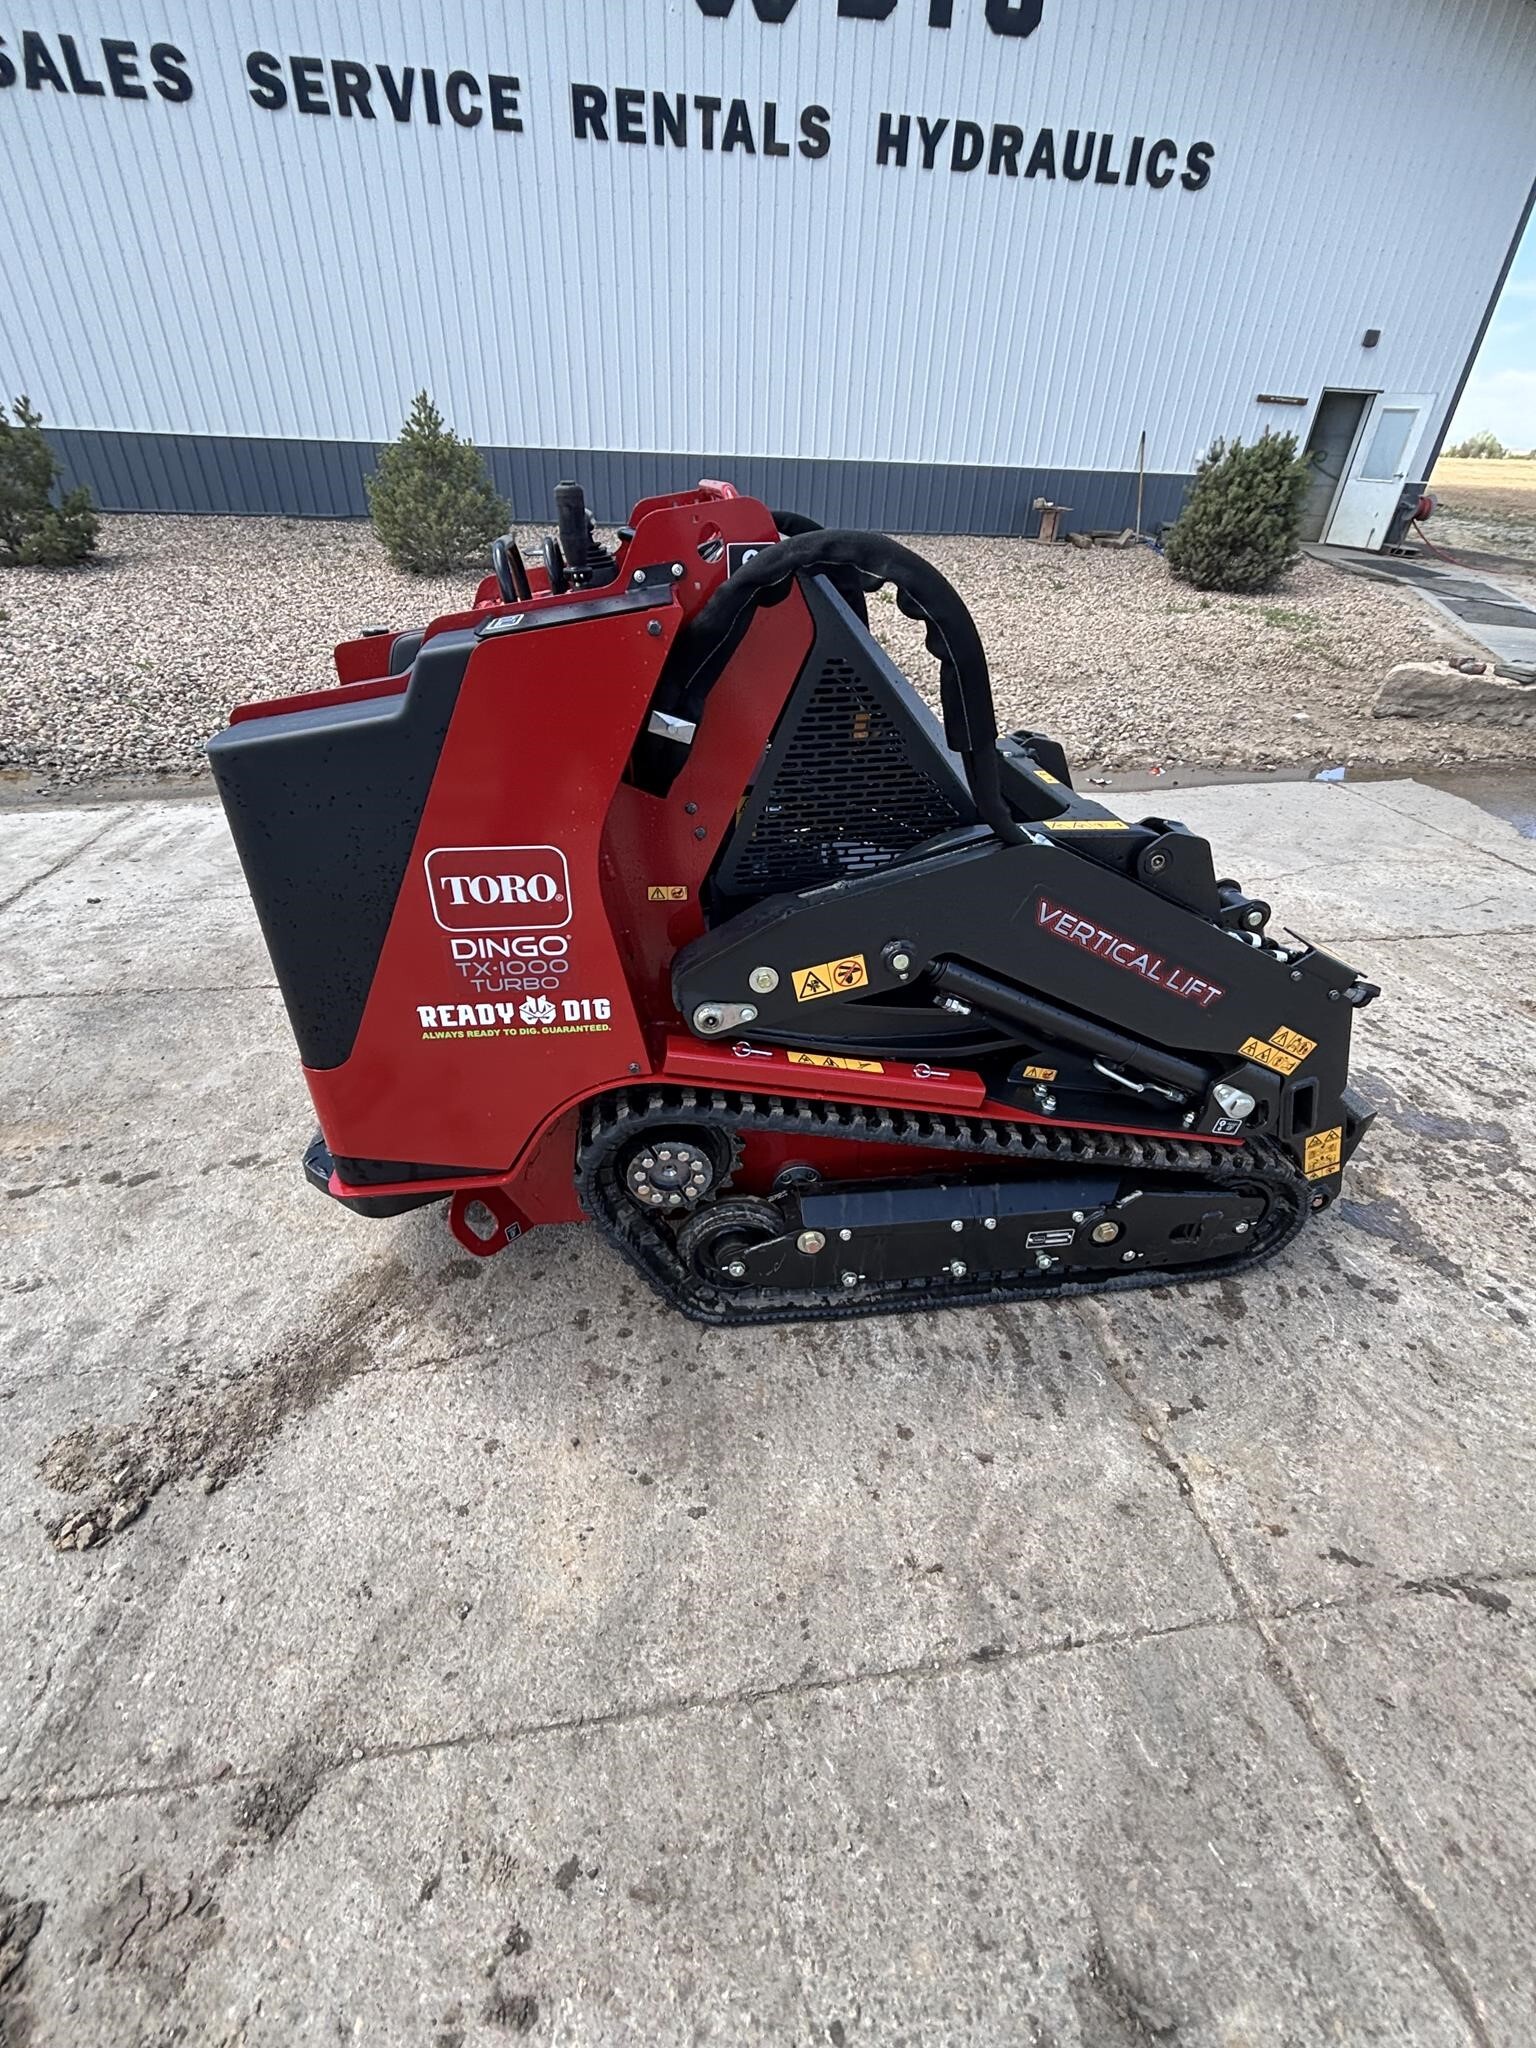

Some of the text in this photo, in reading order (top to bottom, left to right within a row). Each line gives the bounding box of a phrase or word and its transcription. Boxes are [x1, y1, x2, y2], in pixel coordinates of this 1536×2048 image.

[246, 51, 524, 133] SERVICE
[570, 83, 832, 160] RENTALS
[876, 112, 1216, 191] HYDRAULICS
[440, 873, 558, 905] TORO
[450, 935, 569, 960] DINGO
[1038, 901, 1222, 1005] VERTICAL LIFT
[470, 977, 560, 993] TURBO
[416, 998, 612, 1028] READY DIG
[422, 1030, 465, 1040] ALWAYS
[466, 1028, 501, 1039] READY
[503, 1027, 517, 1036] TO
[542, 1023, 612, 1034] GUARANTEED.
